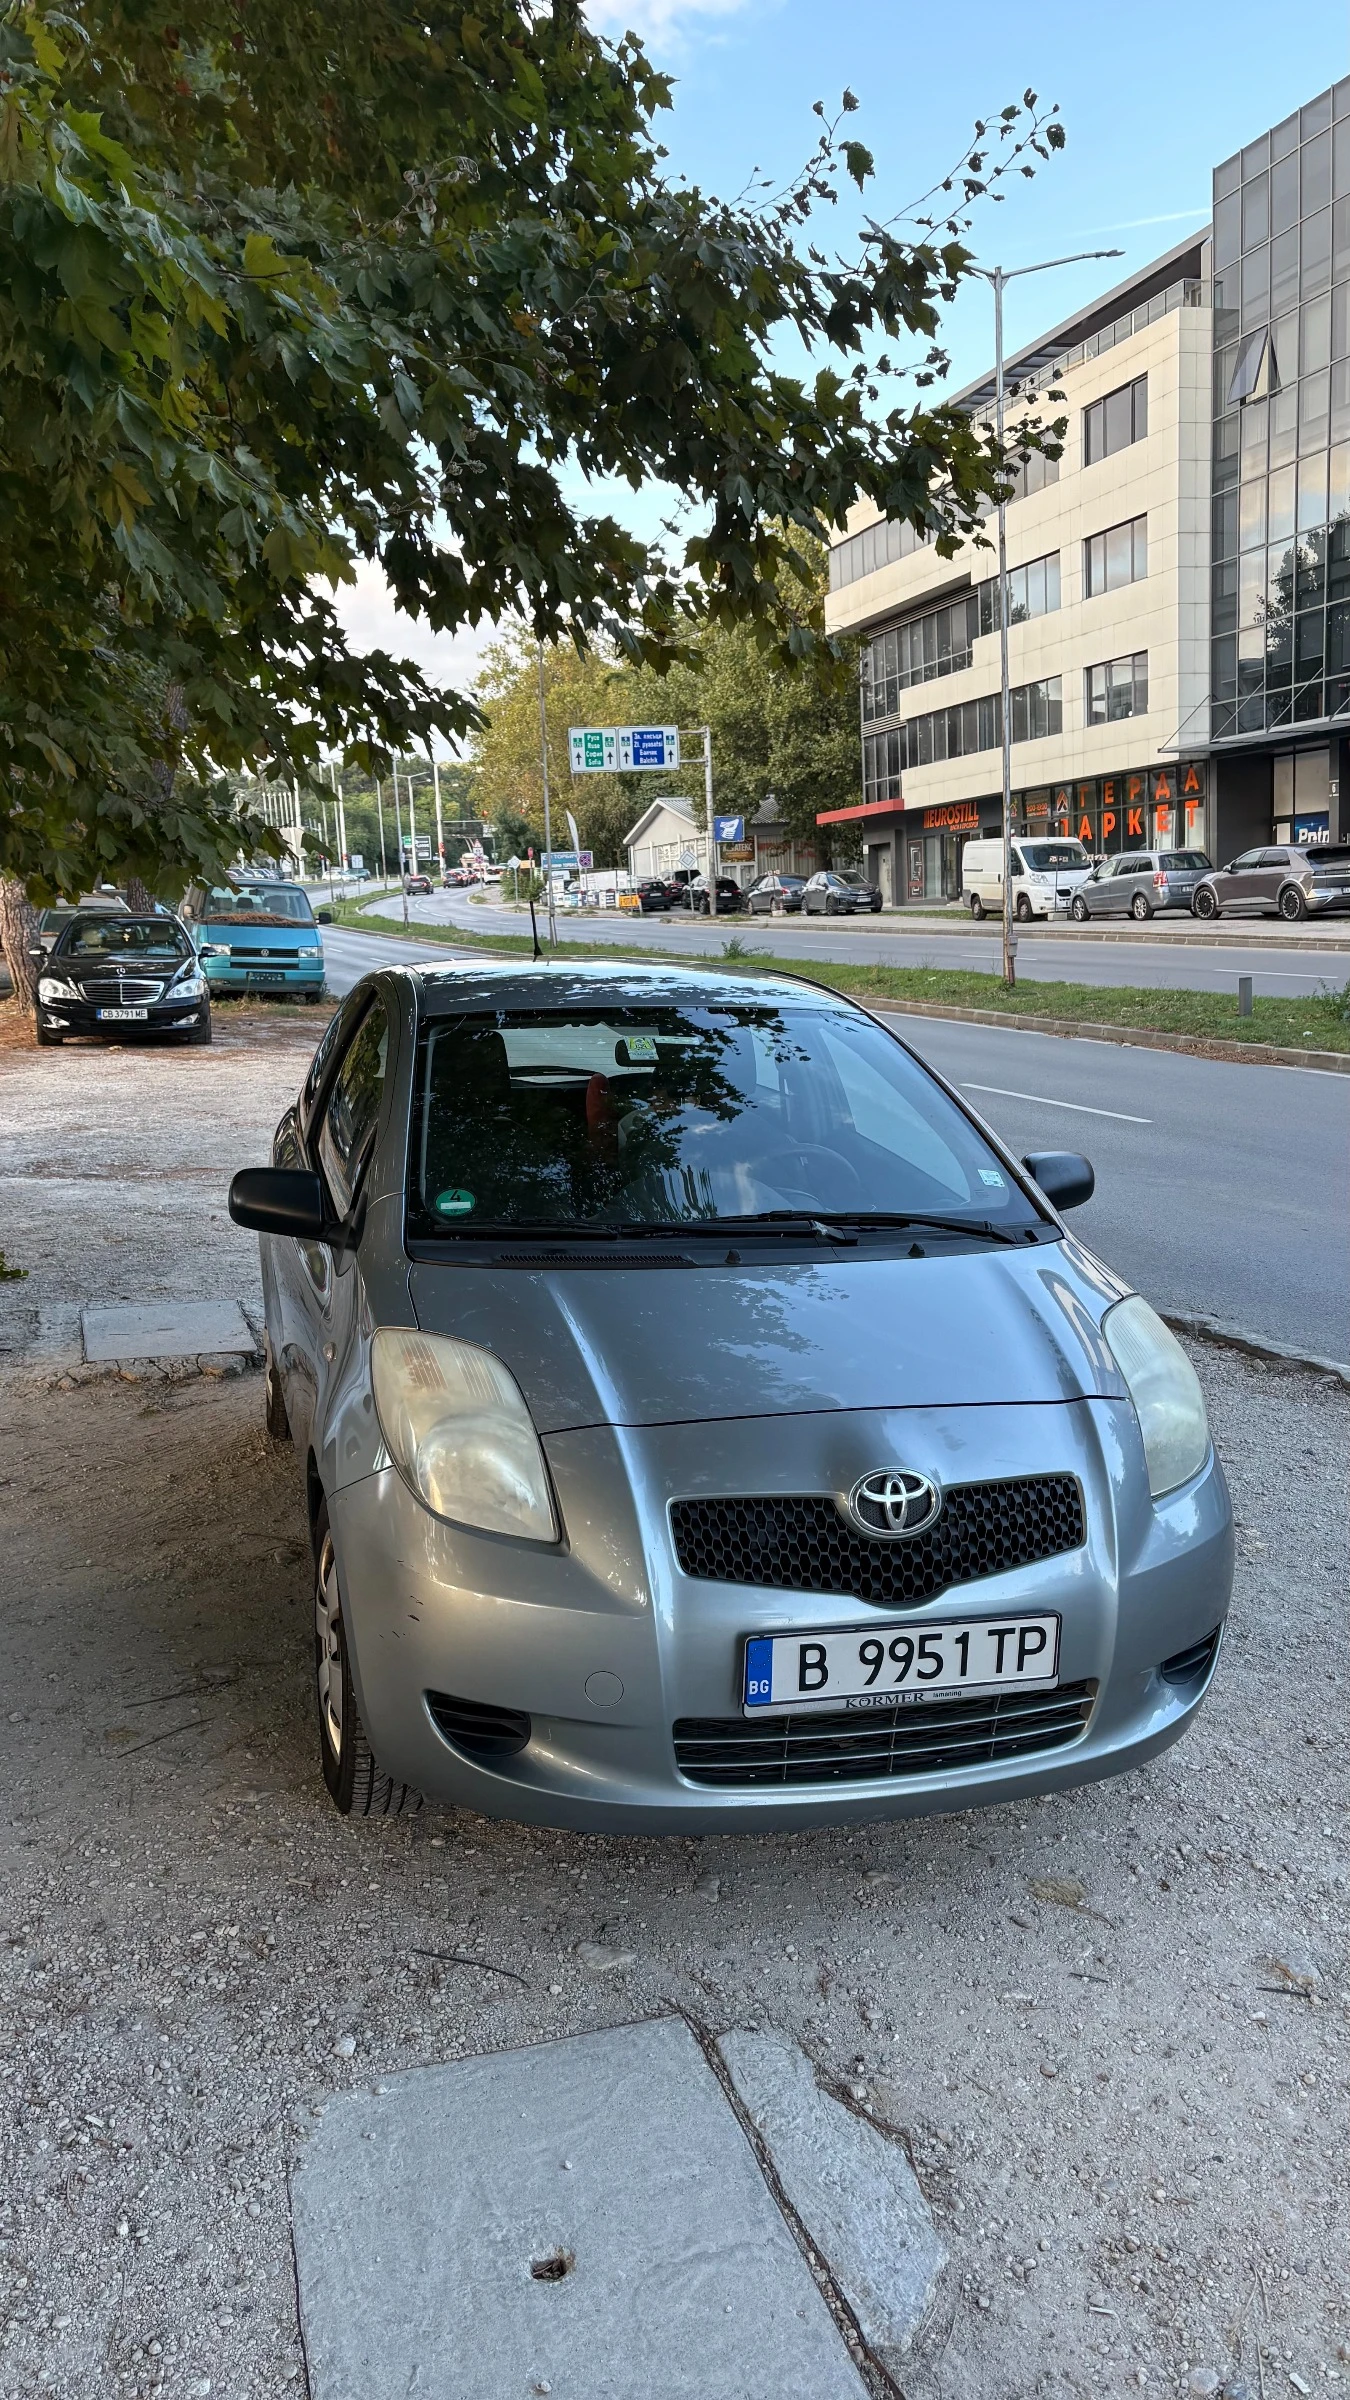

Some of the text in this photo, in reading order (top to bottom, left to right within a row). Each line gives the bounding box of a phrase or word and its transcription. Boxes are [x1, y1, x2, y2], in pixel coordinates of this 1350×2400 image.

[929, 802, 979, 828] EUROSTILL
[114, 1010, 134, 1018] 3791
[450, 1190, 461, 1202] 4
[798, 1625, 1047, 1692] B 9951 TP
[748, 1679, 770, 1695] BG
